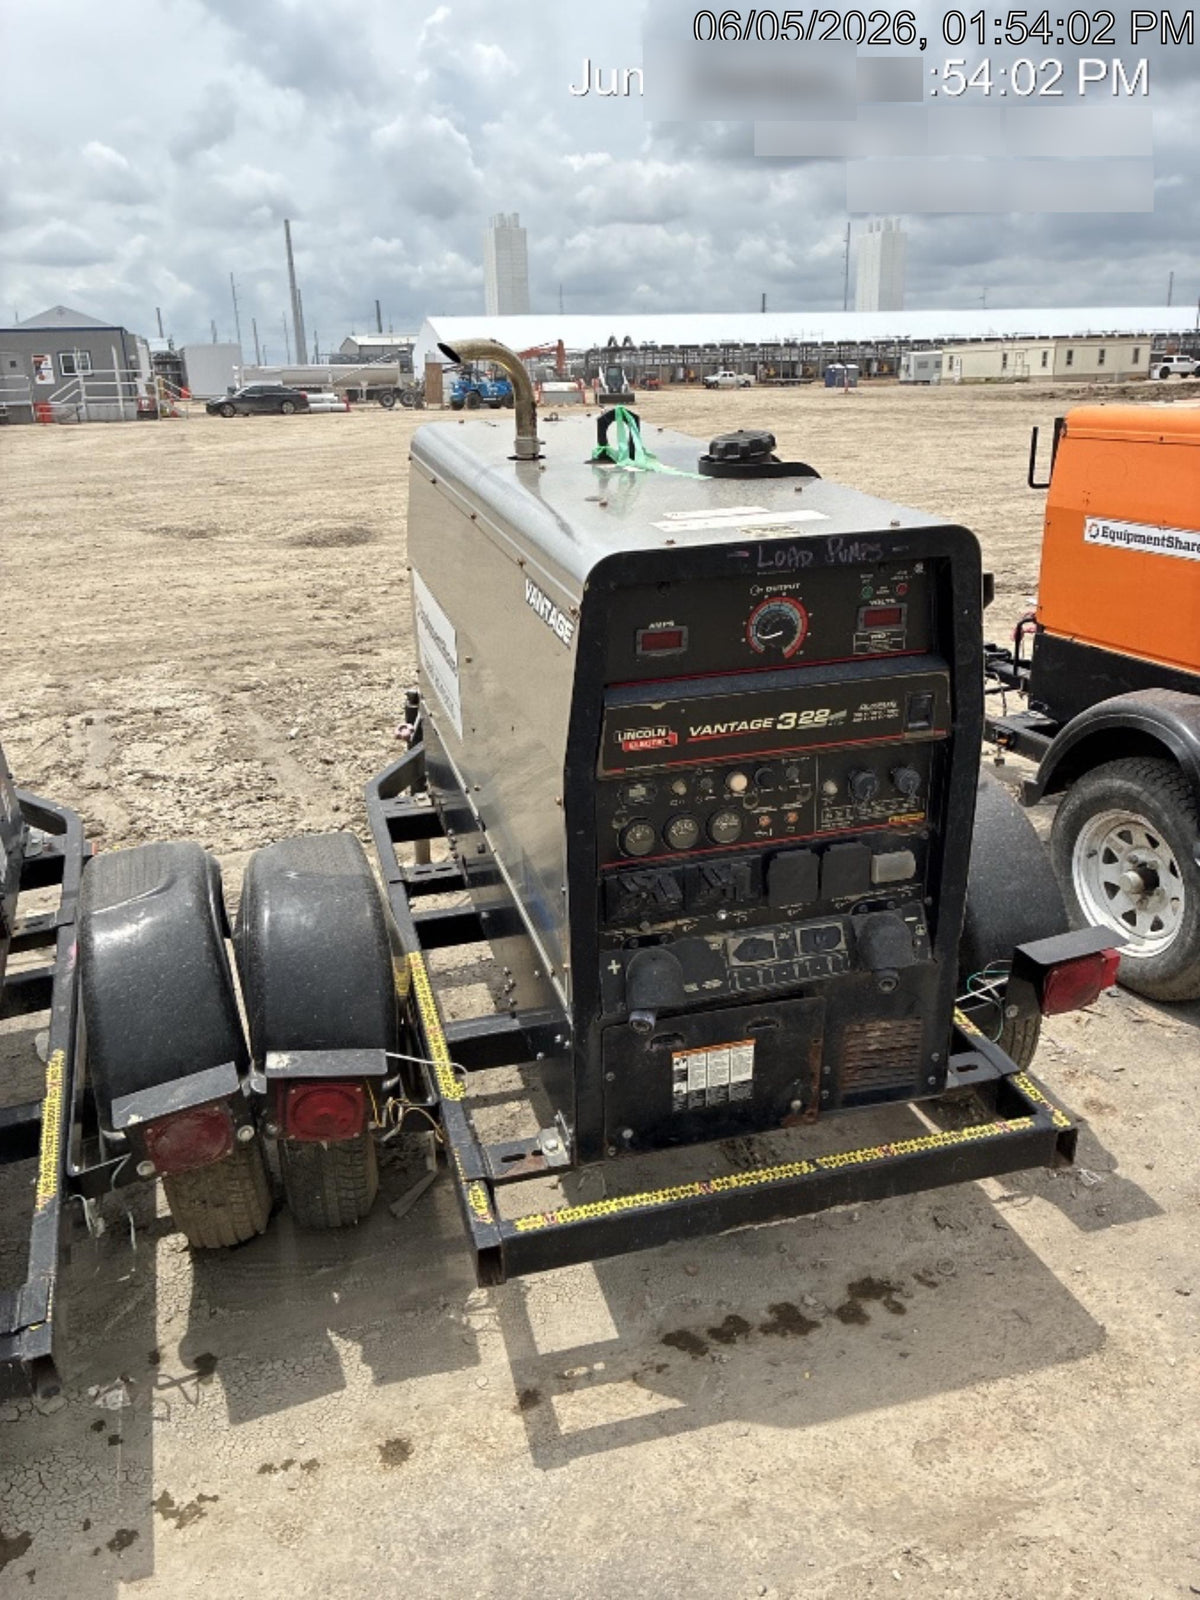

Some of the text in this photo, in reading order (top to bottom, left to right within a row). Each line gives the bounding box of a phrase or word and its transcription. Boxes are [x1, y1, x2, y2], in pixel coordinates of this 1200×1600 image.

[525, 578, 575, 645] VANTAGE
[689, 717, 775, 737] VANTAGE
[776, 708, 831, 730] 322
[618, 728, 666, 742] LINCOLN
[629, 738, 669, 749] ELECTRI
